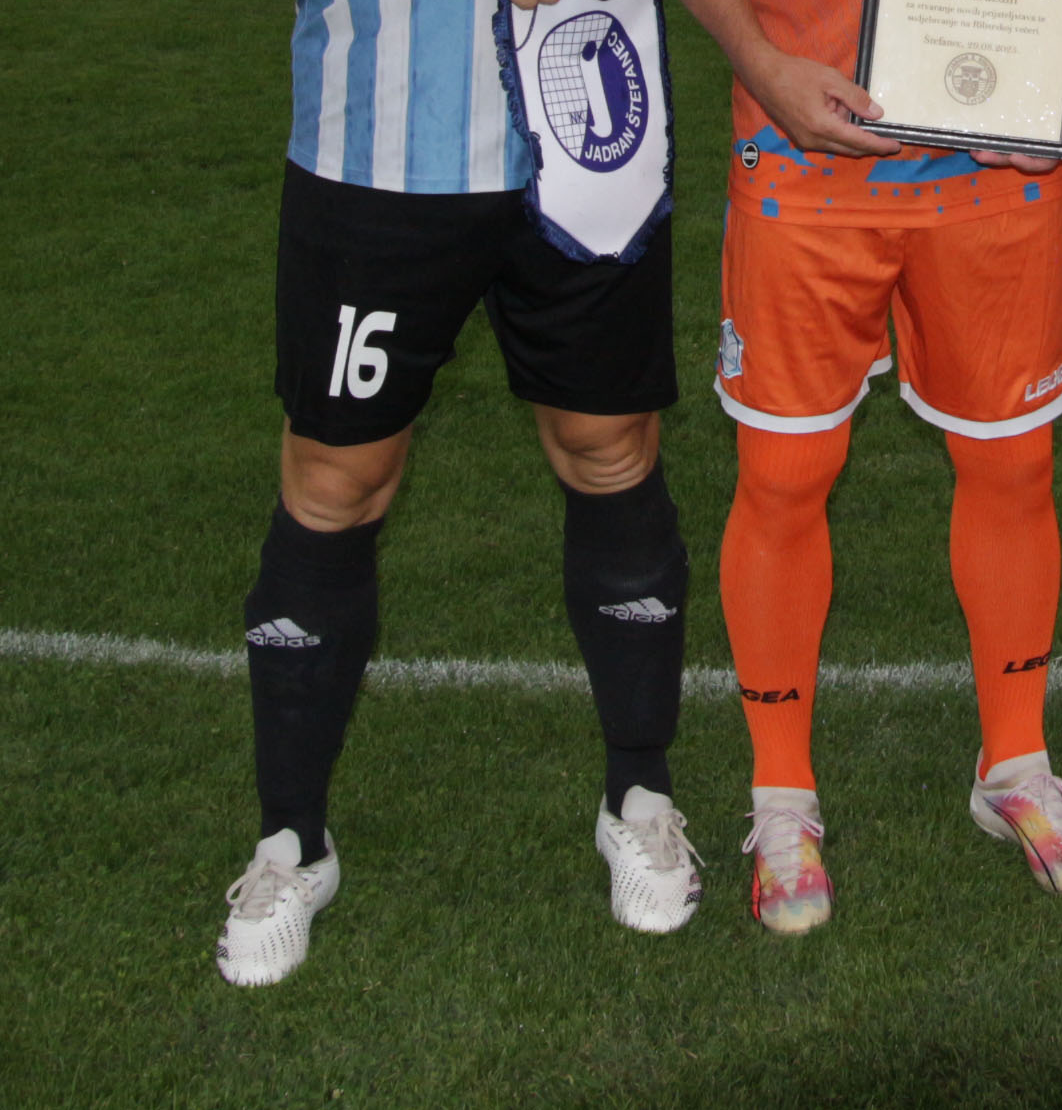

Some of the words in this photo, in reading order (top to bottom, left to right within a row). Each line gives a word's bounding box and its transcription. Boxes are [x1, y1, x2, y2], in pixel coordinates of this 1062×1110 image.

[607, 31, 642, 128] ŠTEFANEC
[584, 127, 636, 163] JADRAN
[329, 304, 397, 399] 16
[740, 686, 800, 704] GEA
